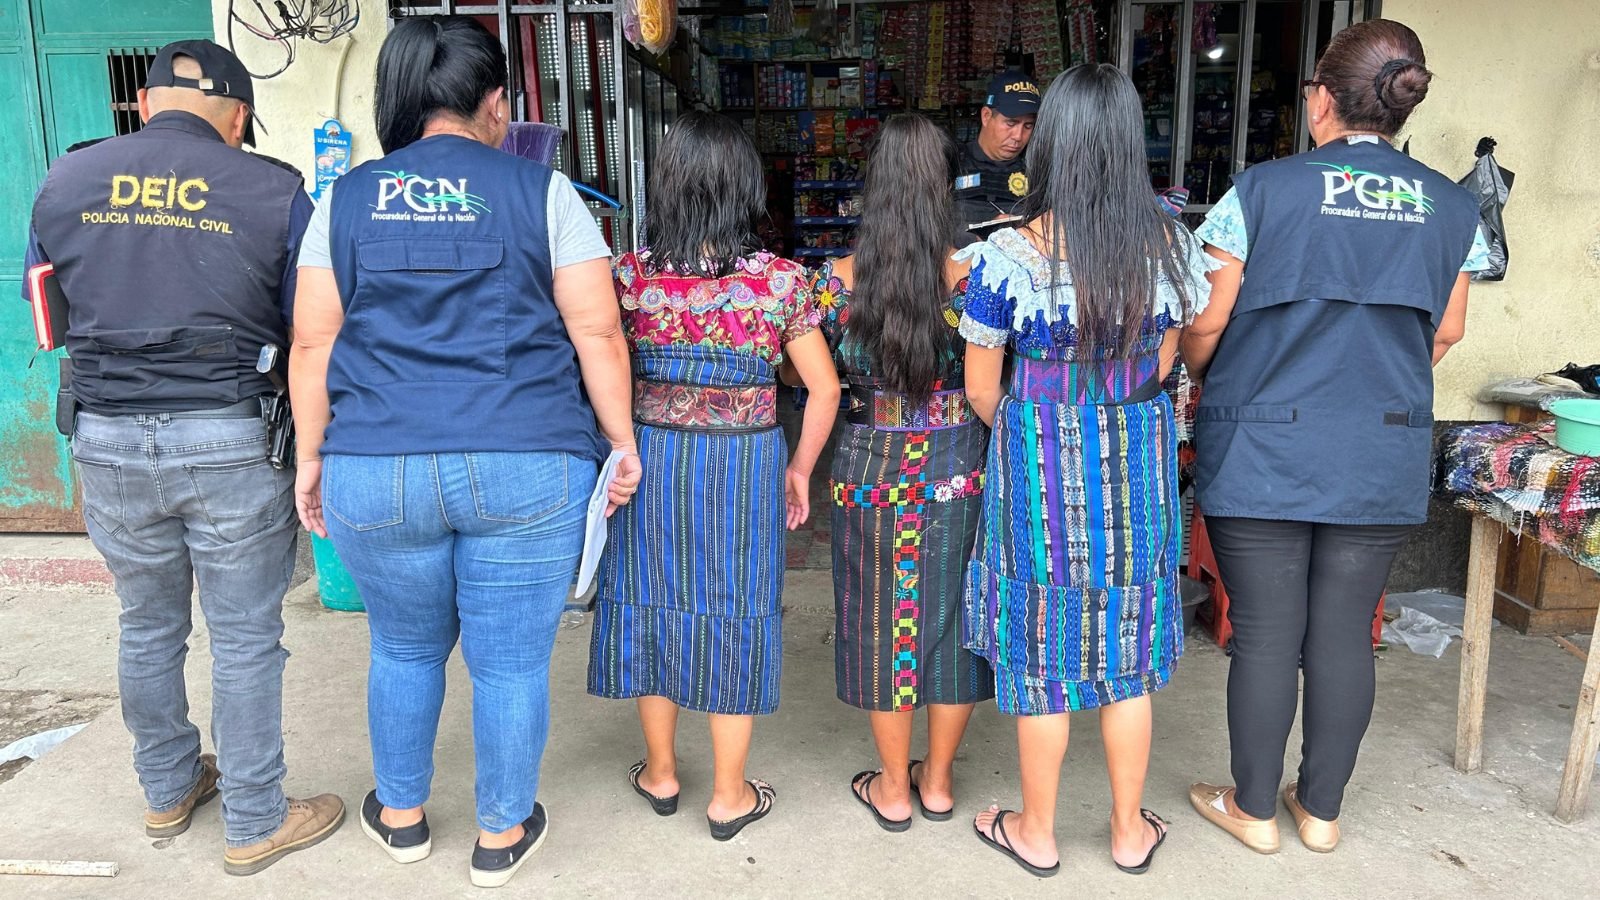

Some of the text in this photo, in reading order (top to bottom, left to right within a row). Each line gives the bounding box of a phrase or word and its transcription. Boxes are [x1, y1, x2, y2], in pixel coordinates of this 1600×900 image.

[111, 175, 210, 212] DEIC
[376, 177, 469, 213] PGN
[1321, 171, 1425, 214] PGN
[81, 212, 233, 234] POLICIA NACIONAL CIVIL
[371, 211, 476, 222] Procuraduría General de la Nación
[1321, 205, 1425, 224] Procuraduría General de la Nación
